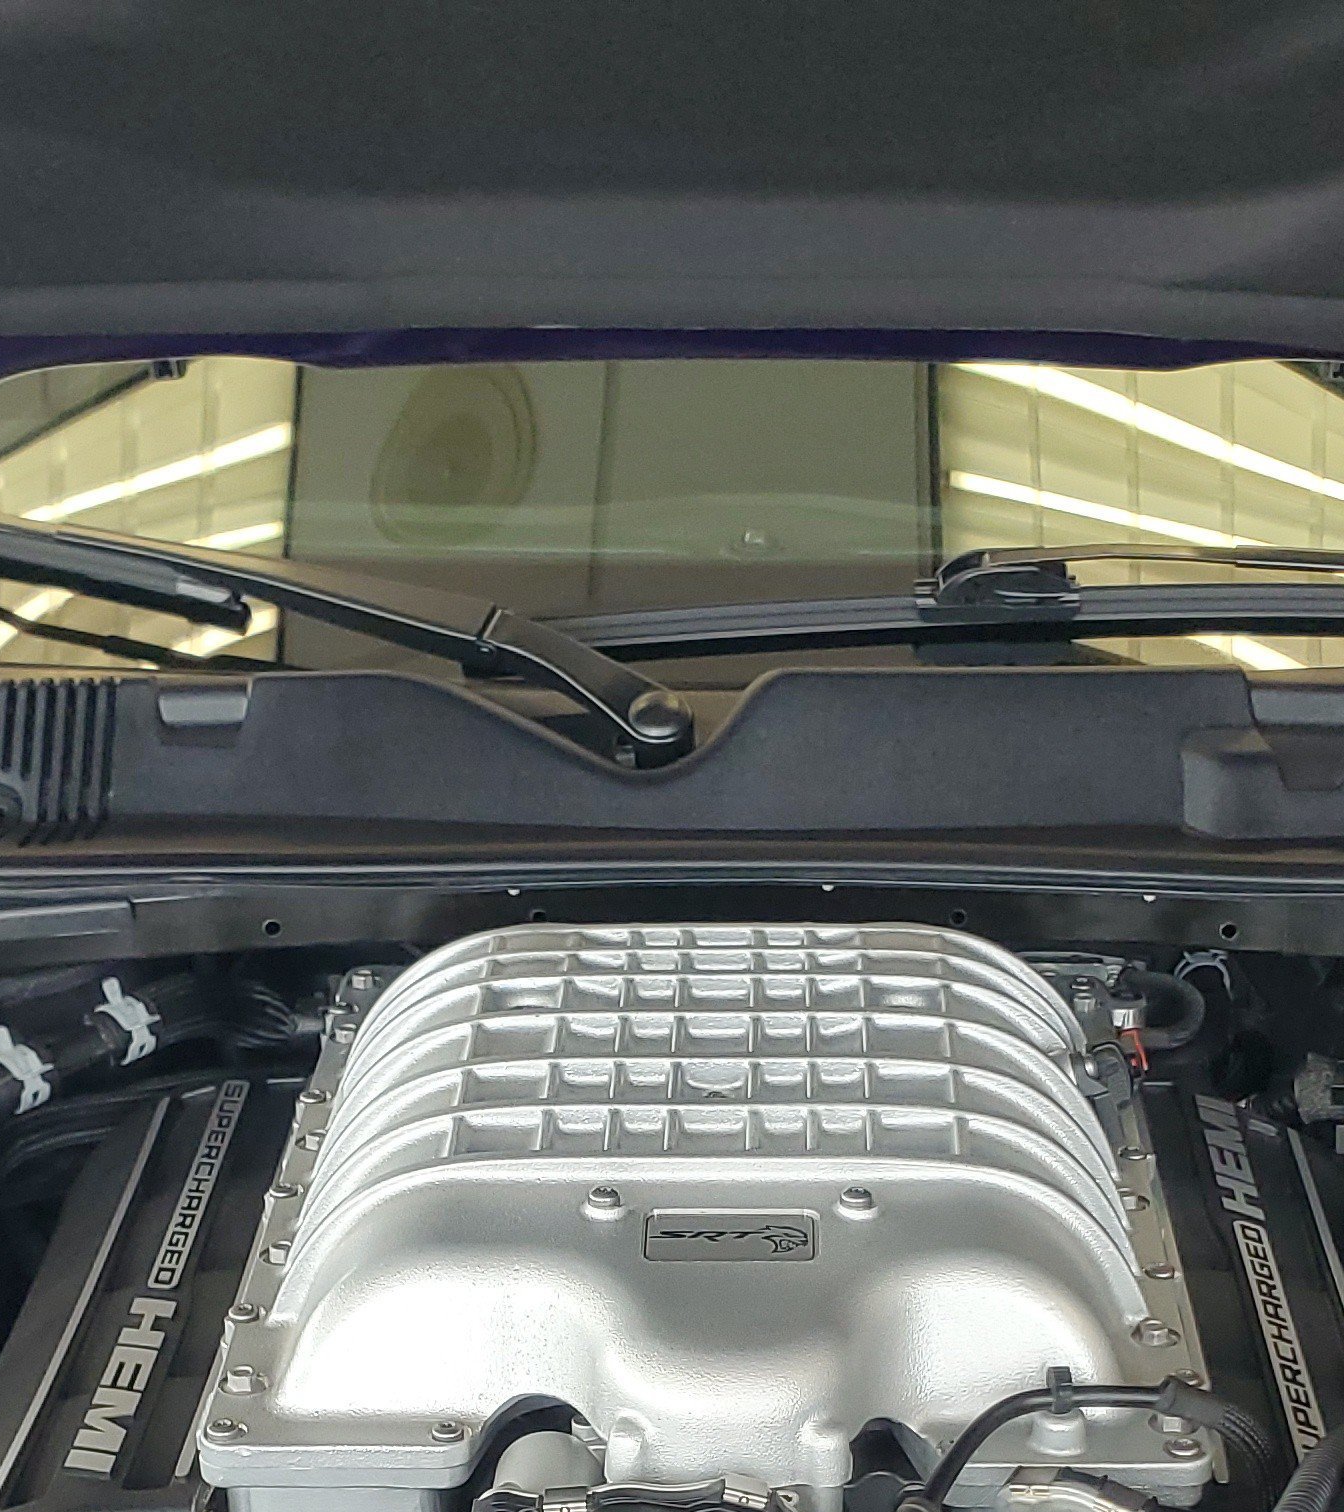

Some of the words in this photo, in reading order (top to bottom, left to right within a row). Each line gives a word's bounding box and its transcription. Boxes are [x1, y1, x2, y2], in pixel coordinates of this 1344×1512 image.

[153, 1082, 244, 1286] SUPERCHARGED
[649, 1230, 765, 1242] SRT
[1195, 1094, 1267, 1221] HEMI
[62, 1297, 178, 1476] HEMI
[1239, 1223, 1322, 1453] UPERCHARGED
